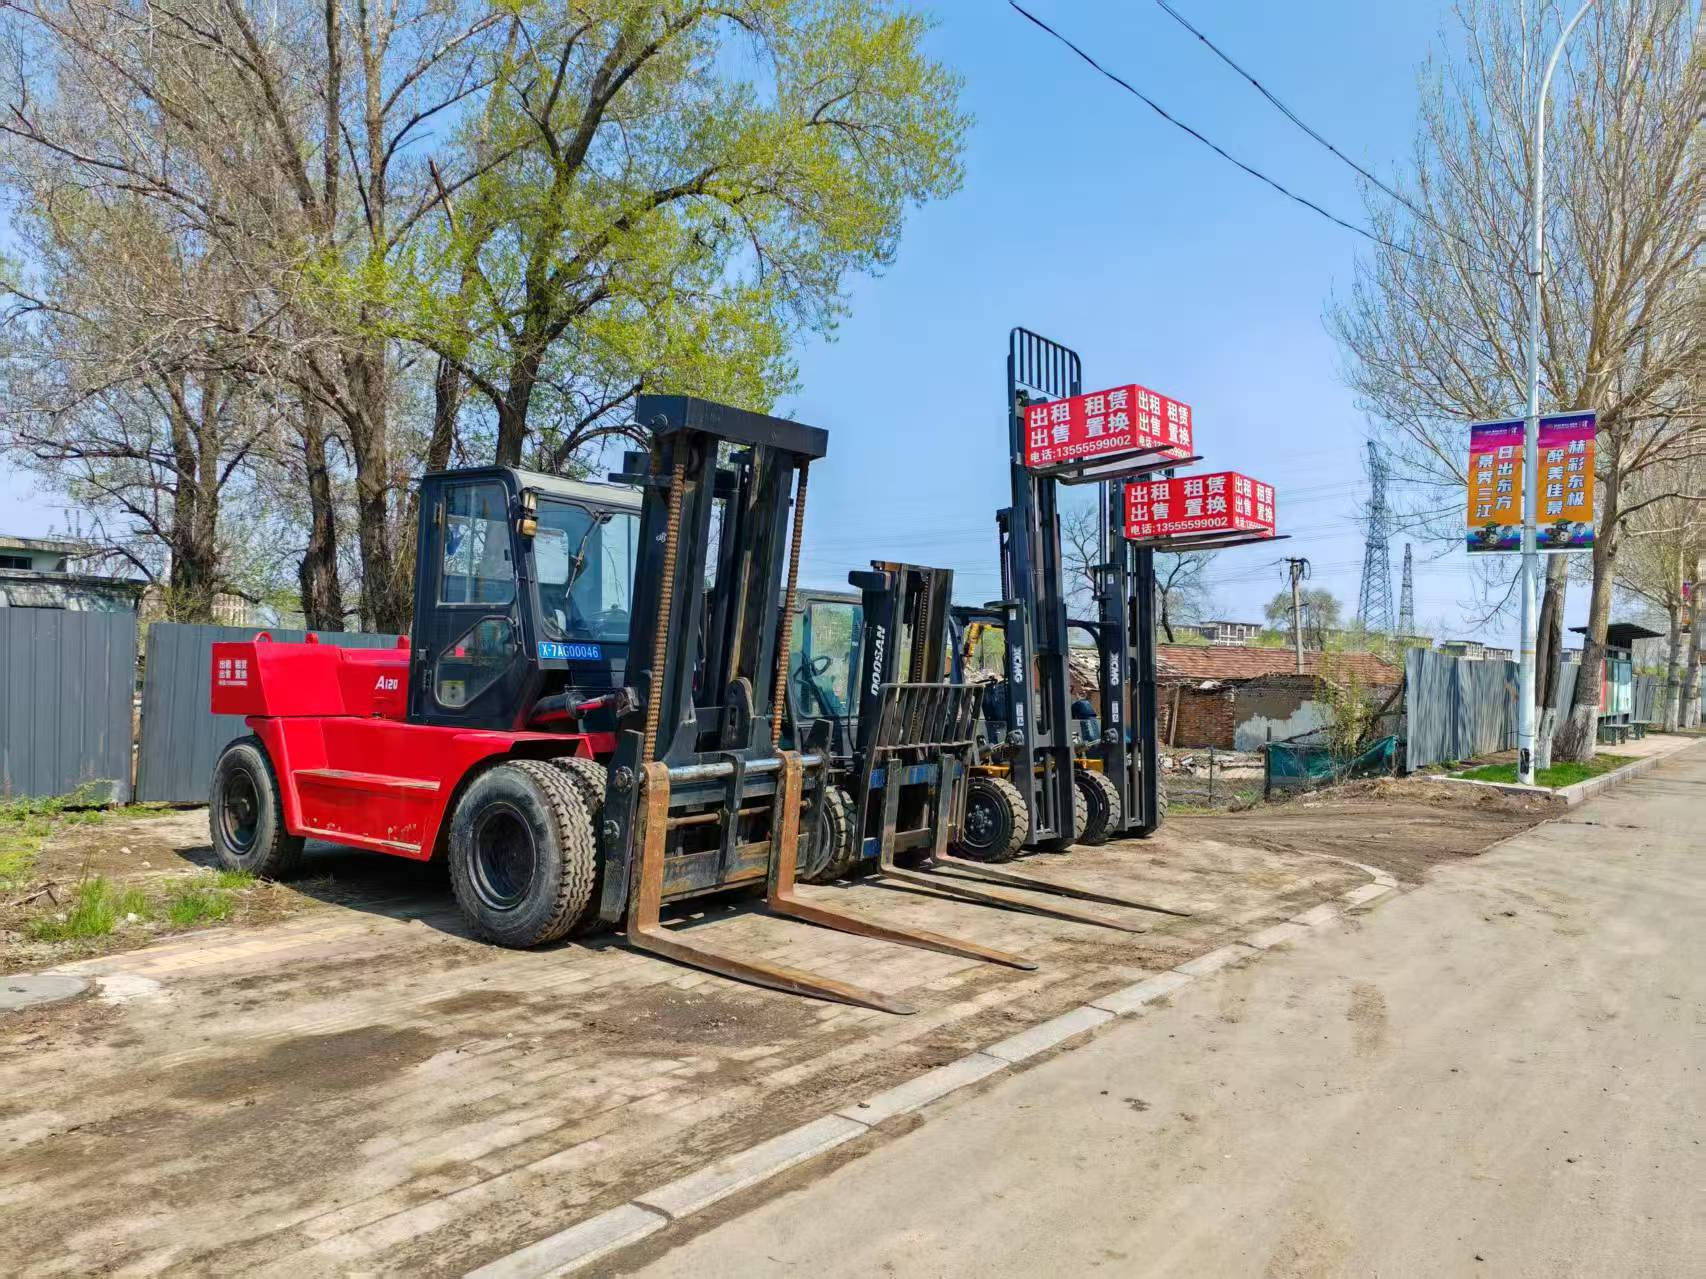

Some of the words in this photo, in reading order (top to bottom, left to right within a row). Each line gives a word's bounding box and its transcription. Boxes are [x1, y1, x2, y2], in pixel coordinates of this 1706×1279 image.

[1030, 402, 1071, 428] 出租
[1085, 389, 1129, 417] 租赁
[1138, 389, 1161, 415] 出租
[1167, 401, 1189, 427] 租赁
[1030, 423, 1070, 448] 出售
[1085, 412, 1130, 438] 置换
[1139, 412, 1161, 437] 出售
[1168, 422, 1191, 446] 置换
[1030, 435, 1131, 463] 电话:13555599002
[1131, 483, 1170, 503] 出租
[1184, 475, 1226, 498] 租赁
[1235, 475, 1252, 498] 出租
[1256, 483, 1273, 505] 租赁
[1496, 445, 1514, 510] 日出东方
[1130, 516, 1229, 535] 电话:13555599002
[1131, 502, 1169, 522] 出售
[1184, 496, 1227, 517] 置换
[1235, 495, 1252, 517] 出售
[1257, 502, 1273, 523] 置换
[870, 624, 886, 697] DOOSAN
[1012, 643, 1023, 684] XCMG
[1109, 650, 1119, 686] XCMG
[374, 675, 398, 690] A120
